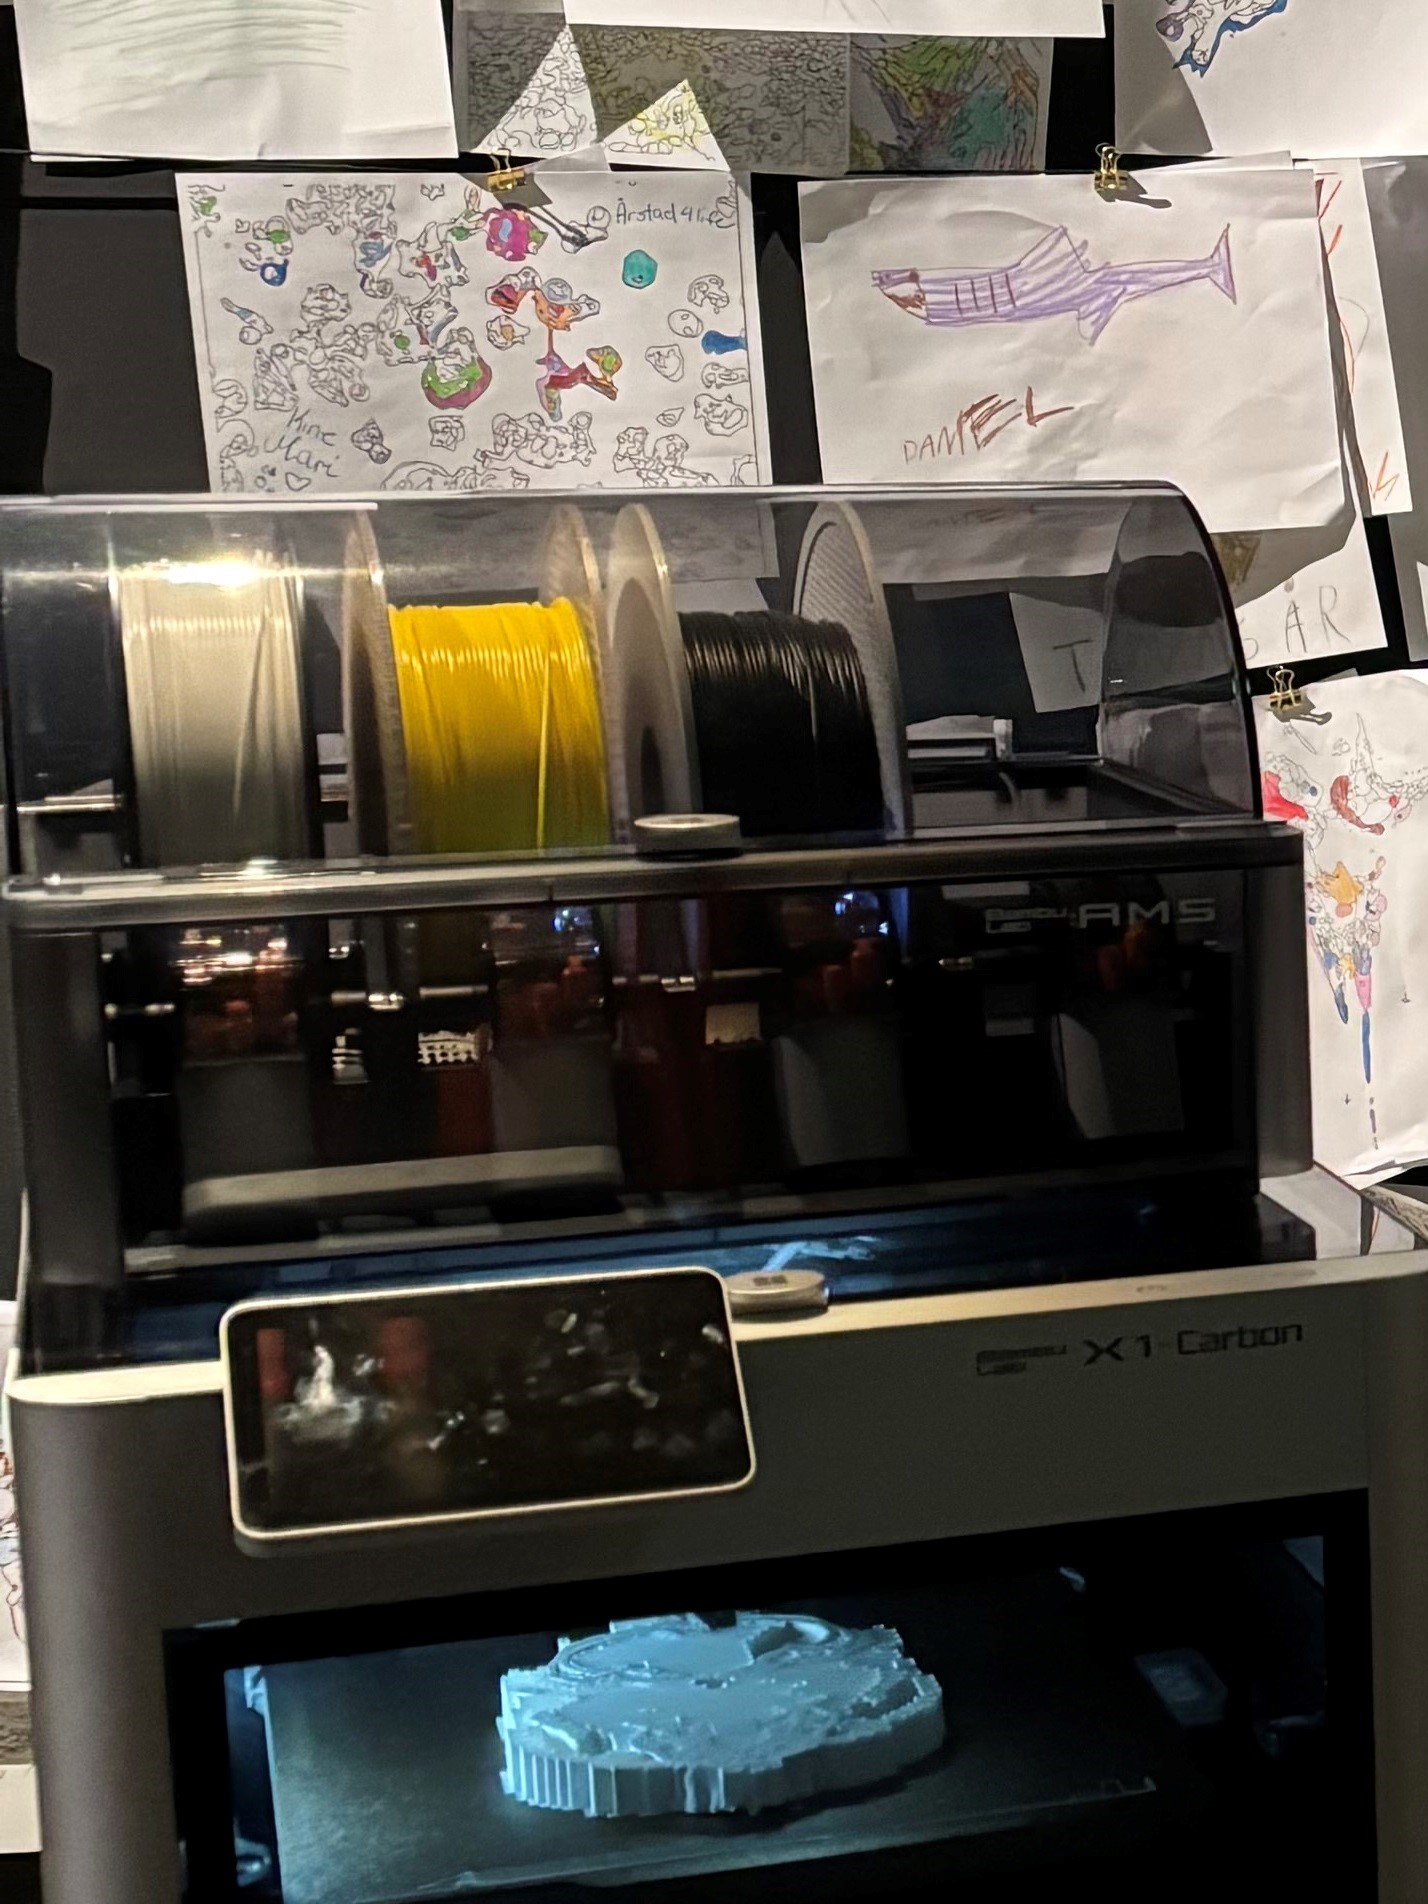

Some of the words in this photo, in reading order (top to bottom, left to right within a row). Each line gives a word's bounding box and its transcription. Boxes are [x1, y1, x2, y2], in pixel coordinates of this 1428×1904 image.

[616, 197, 677, 225] Årstad
[1078, 898, 1216, 929] AMS
[1083, 1334, 1152, 1367] X1
[1177, 1323, 1303, 1356] Carbon
